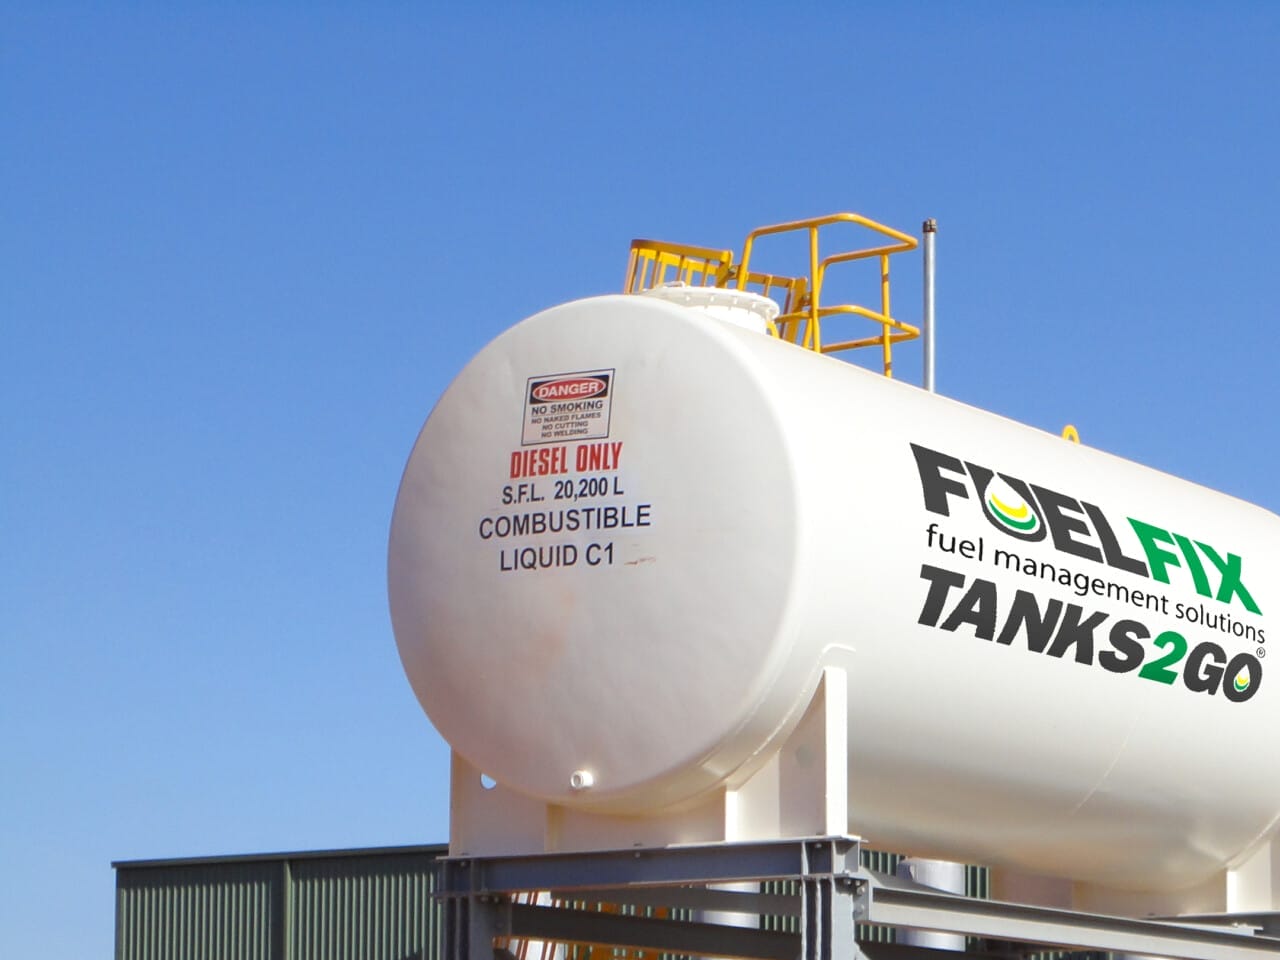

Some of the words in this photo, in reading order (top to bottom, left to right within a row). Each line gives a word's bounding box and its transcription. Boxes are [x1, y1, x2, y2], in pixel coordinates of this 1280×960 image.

[538, 382, 599, 398] DANGER
[531, 405, 547, 416] NO
[550, 400, 603, 414] SMOKING
[554, 420, 589, 429] CUTTING
[509, 446, 568, 479] DIESEL
[576, 441, 623, 472] ONLY
[502, 483, 545, 505] S.F.L.
[554, 477, 608, 501] 20,200
[613, 476, 624, 495] L
[479, 504, 651, 539] COMBUSTIBLE
[500, 544, 578, 571] LIQUID
[585, 542, 614, 566] C1
[926, 523, 984, 562] fuel
[994, 547, 1168, 616] management
[1175, 602, 1266, 644] solutions
[917, 564, 1263, 703] TANKS2GO
